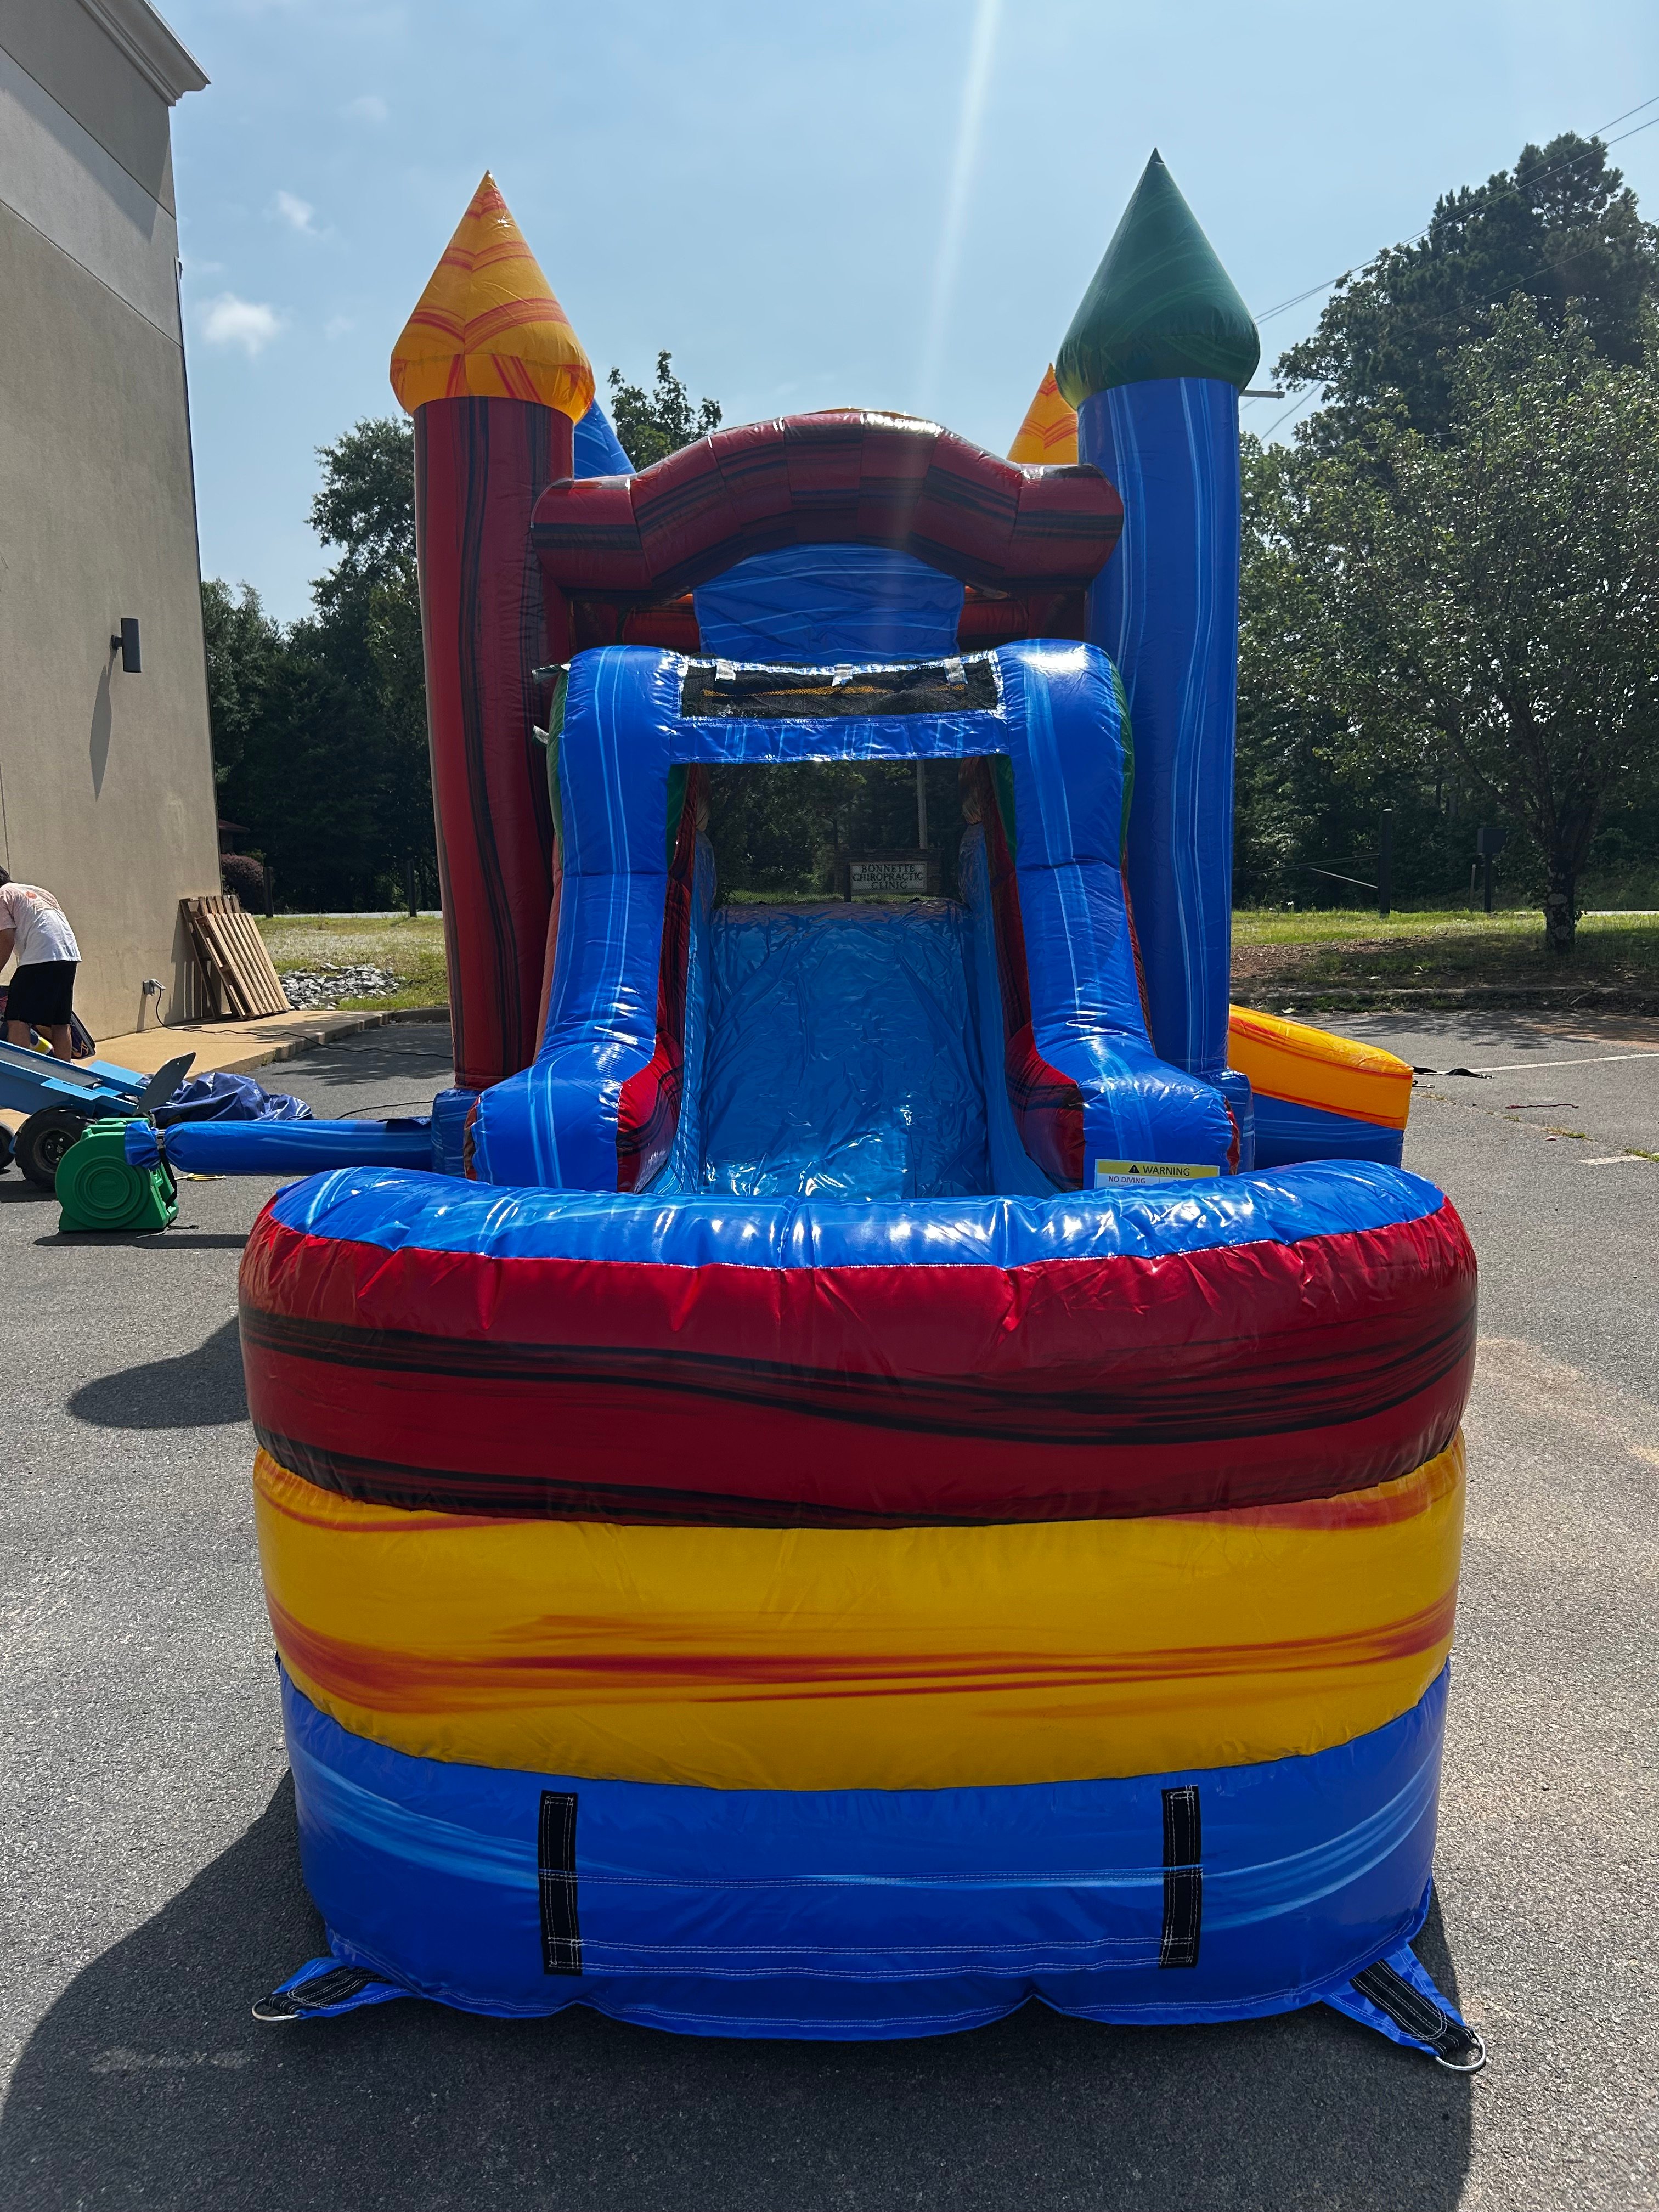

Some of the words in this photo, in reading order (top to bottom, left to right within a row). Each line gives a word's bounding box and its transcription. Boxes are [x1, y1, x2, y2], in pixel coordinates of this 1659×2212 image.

[861, 864, 916, 873] BONNETTE
[852, 872, 923, 881] CHIROPRACTIC
[1143, 1165, 1190, 1176] WARNING
